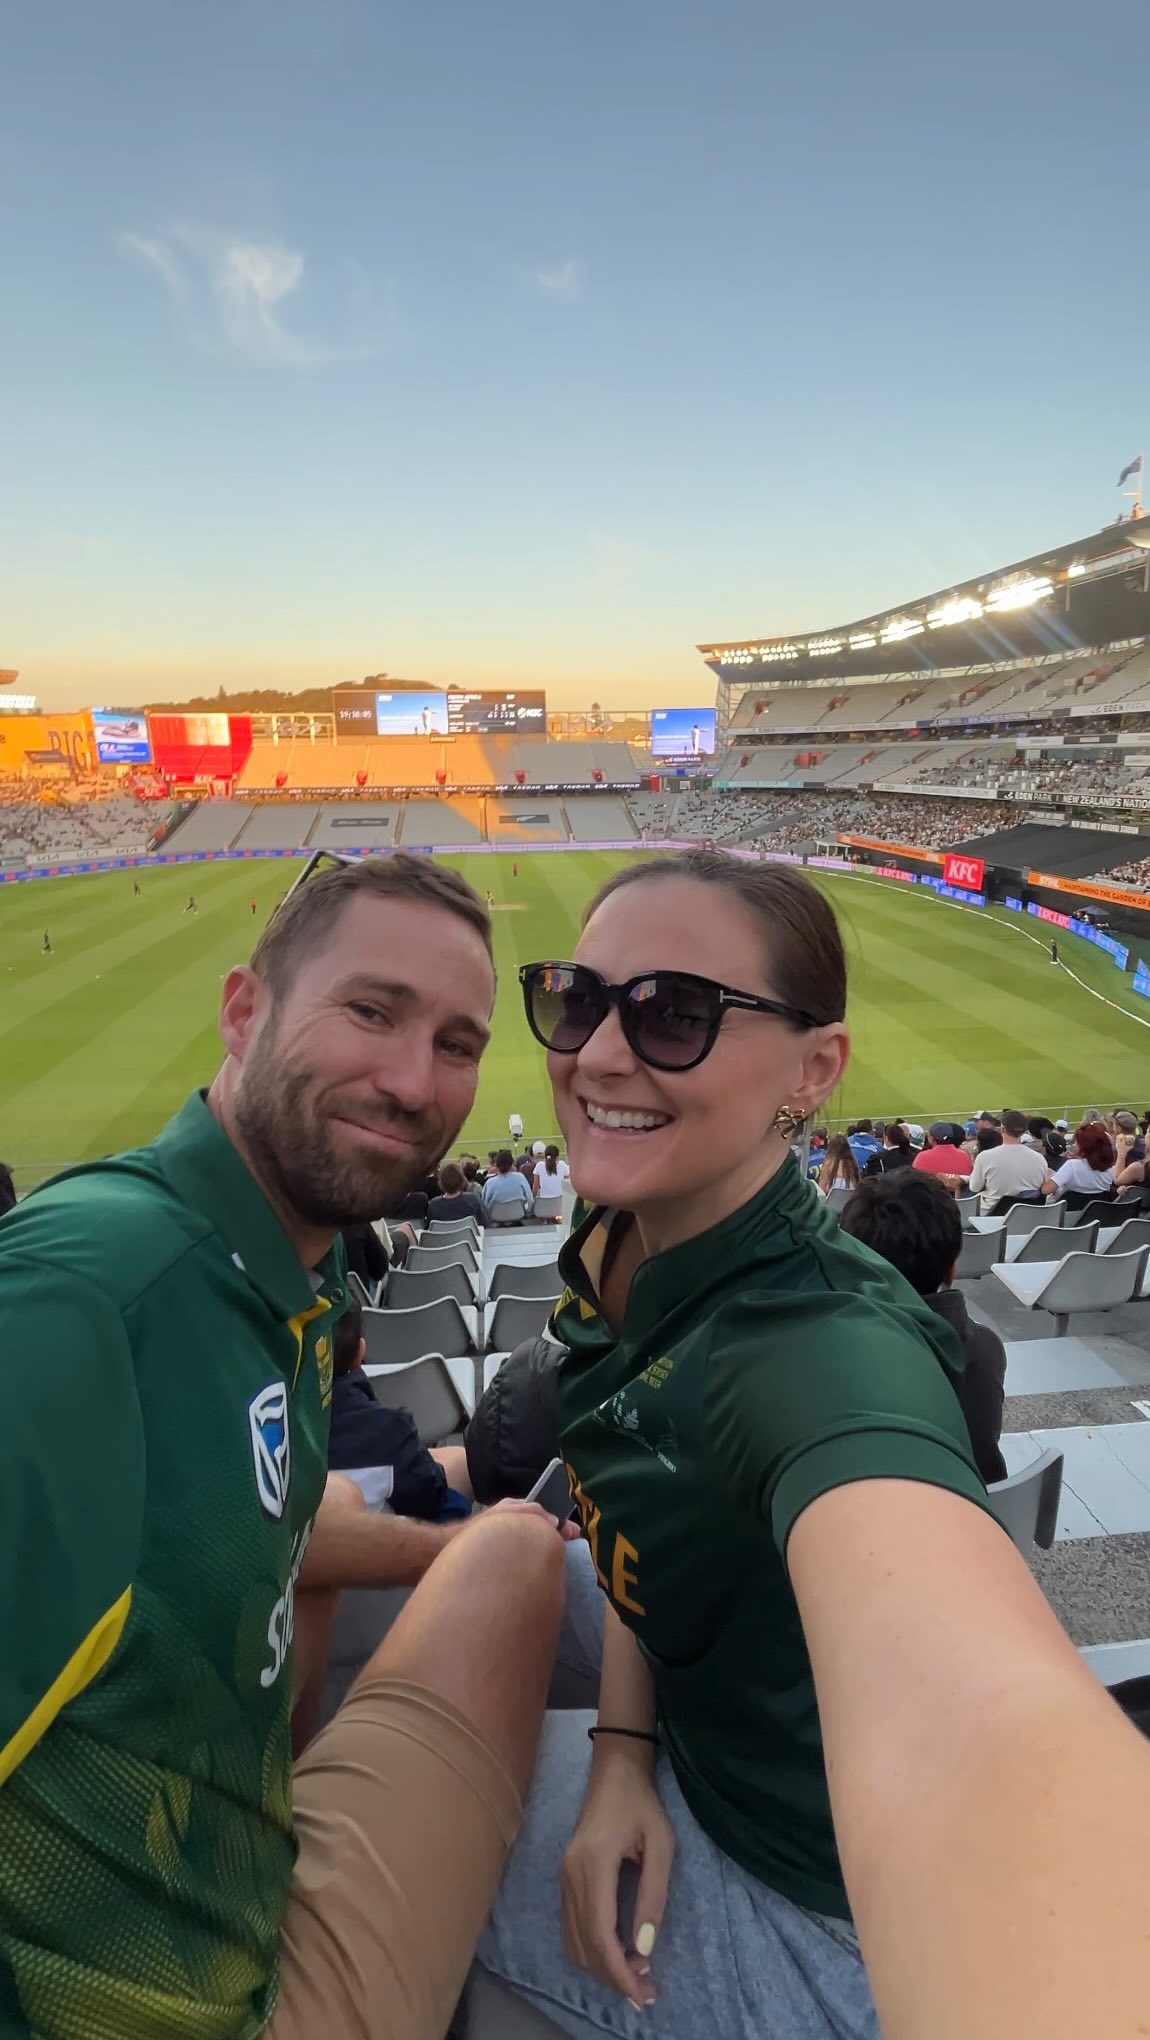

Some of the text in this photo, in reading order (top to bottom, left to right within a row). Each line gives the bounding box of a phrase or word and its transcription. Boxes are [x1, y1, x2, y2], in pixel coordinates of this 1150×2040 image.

[1015, 791, 1150, 809] EDEN PARK NEW ZEALAND'S NATIO
[948, 860, 978, 883] KFC
[1100, 890, 1111, 898] THE
[1112, 892, 1136, 904] GARDEN
[1138, 897, 1147, 905] OF
